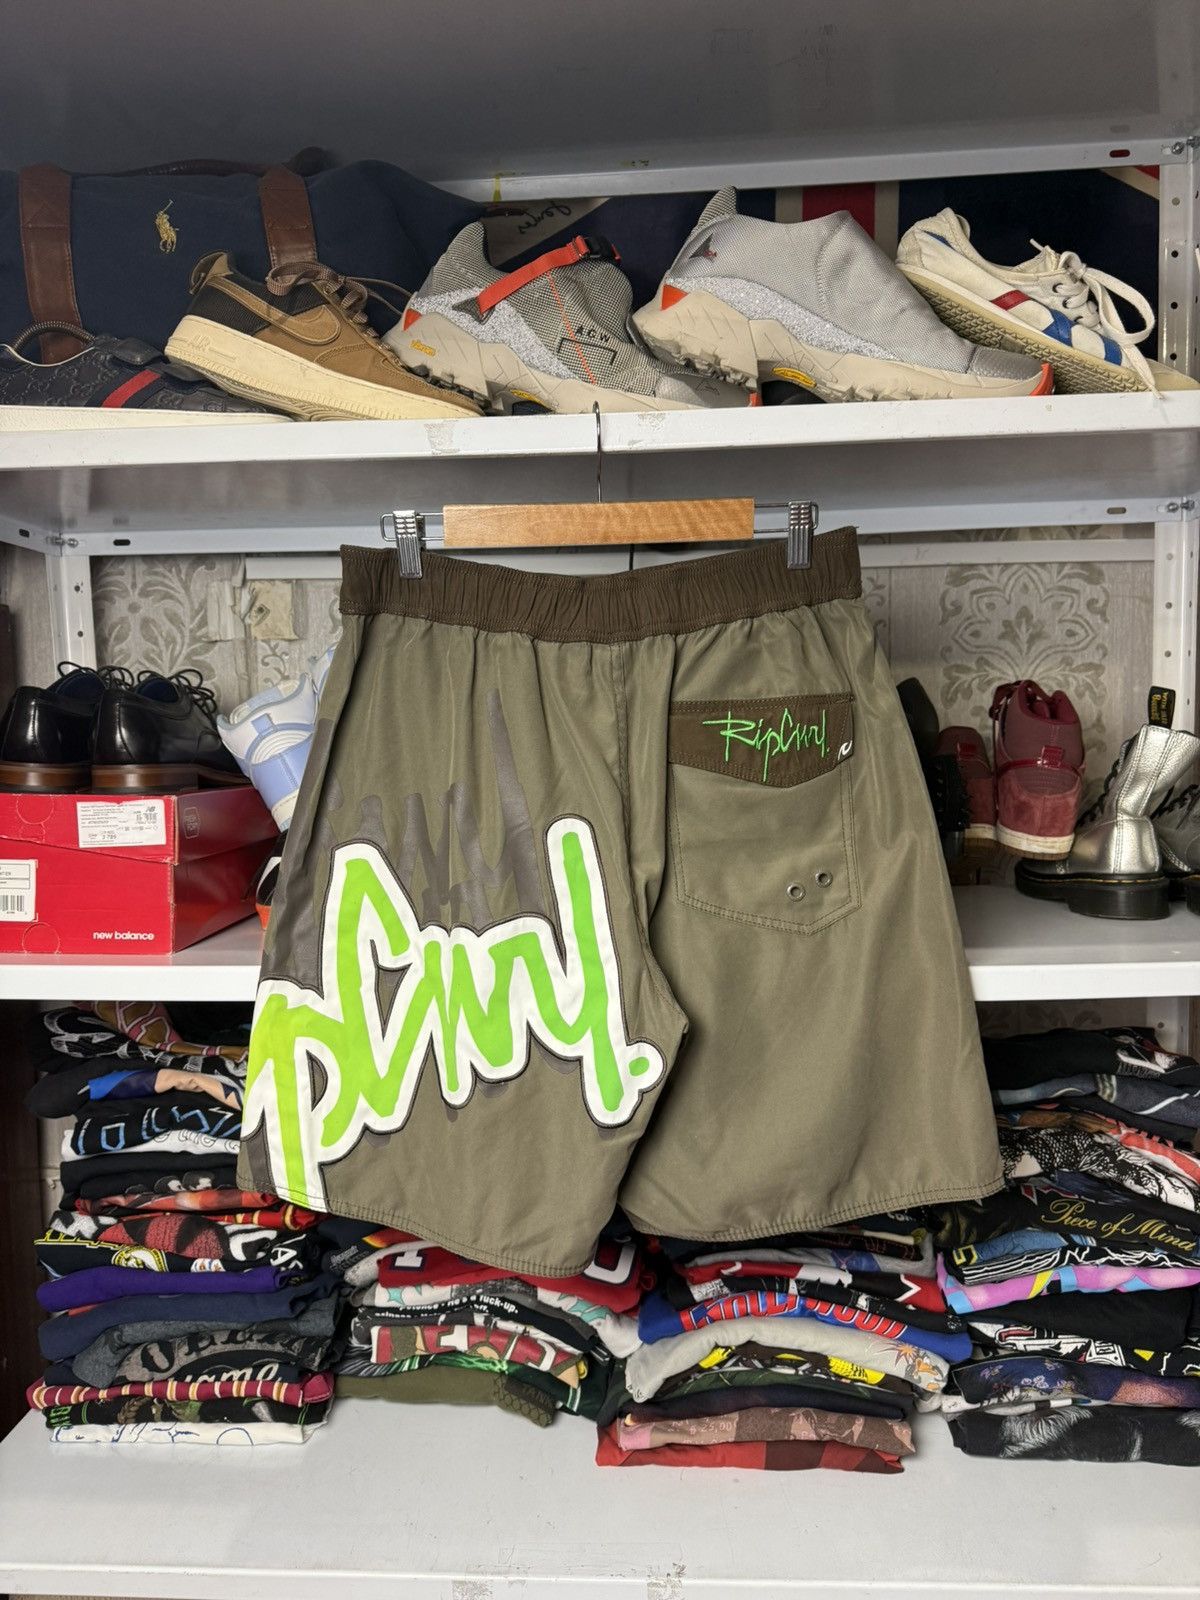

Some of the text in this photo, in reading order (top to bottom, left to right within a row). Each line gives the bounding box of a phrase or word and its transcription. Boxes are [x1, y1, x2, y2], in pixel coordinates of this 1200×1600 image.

[93, 930, 155, 940] new balance
[1041, 1199, 1196, 1251] Piece of Mind
